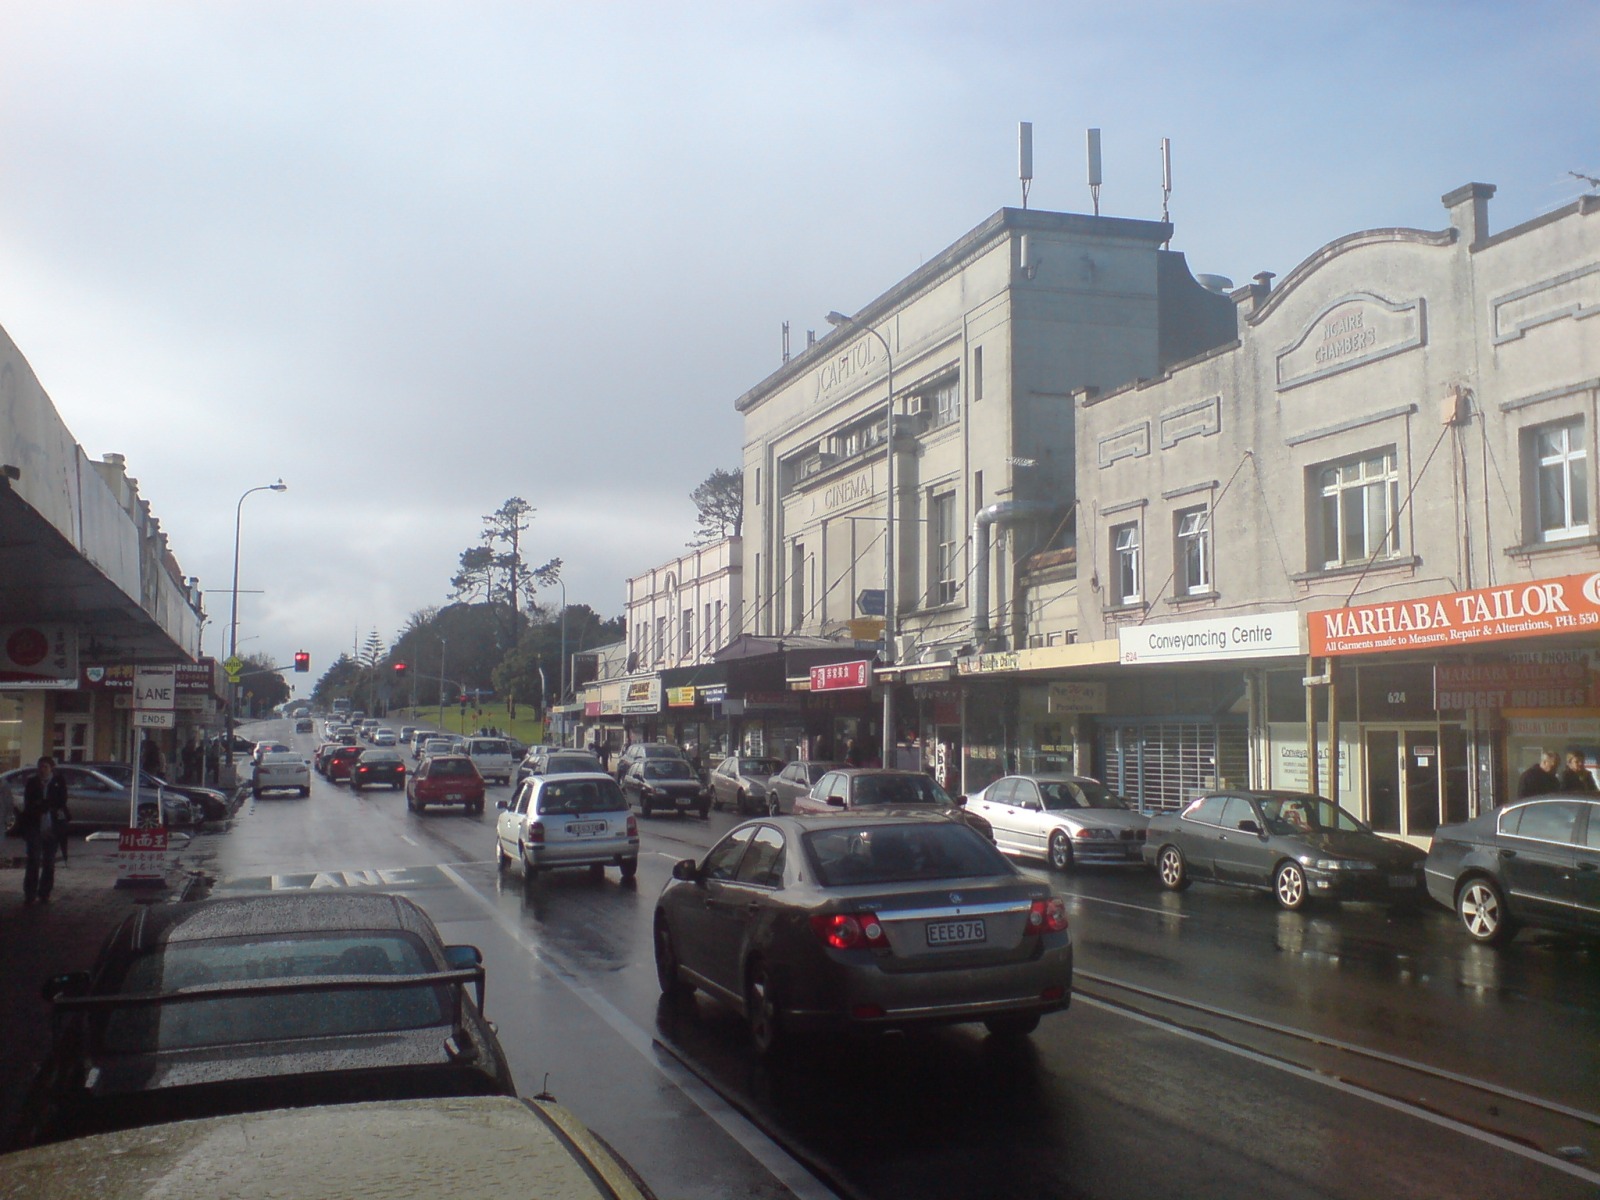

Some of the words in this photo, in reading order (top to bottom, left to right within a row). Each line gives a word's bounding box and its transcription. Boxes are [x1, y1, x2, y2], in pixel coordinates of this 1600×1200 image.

[1316, 327, 1375, 364] CHAMBERS
[821, 337, 875, 392] CAPITOL
[825, 475, 870, 510] CINEMA
[1324, 600, 1451, 639] MARHABA
[1456, 583, 1569, 624] TAILOR
[1149, 629, 1227, 650] Conveyancing
[1232, 625, 1273, 643] Centre
[1325, 641, 1336, 652] All
[1338, 640, 1374, 651] Garments
[1375, 636, 1397, 646] made
[1398, 636, 1407, 645] to
[1409, 631, 1448, 643] Measure,
[1450, 626, 1481, 642] Repair
[1483, 625, 1492, 635] &
[1495, 619, 1553, 635] Alterations,
[1555, 615, 1577, 627] PH:
[1579, 612, 1599, 625] 550
[1125, 652, 1138, 662] 624
[136, 688, 171, 700] LANE
[1388, 692, 1406, 703] 624
[1439, 690, 1506, 709] BUDGET
[1511, 688, 1584, 708] MOBILES
[142, 715, 165, 724] ENDS
[929, 923, 984, 944] EEE876
